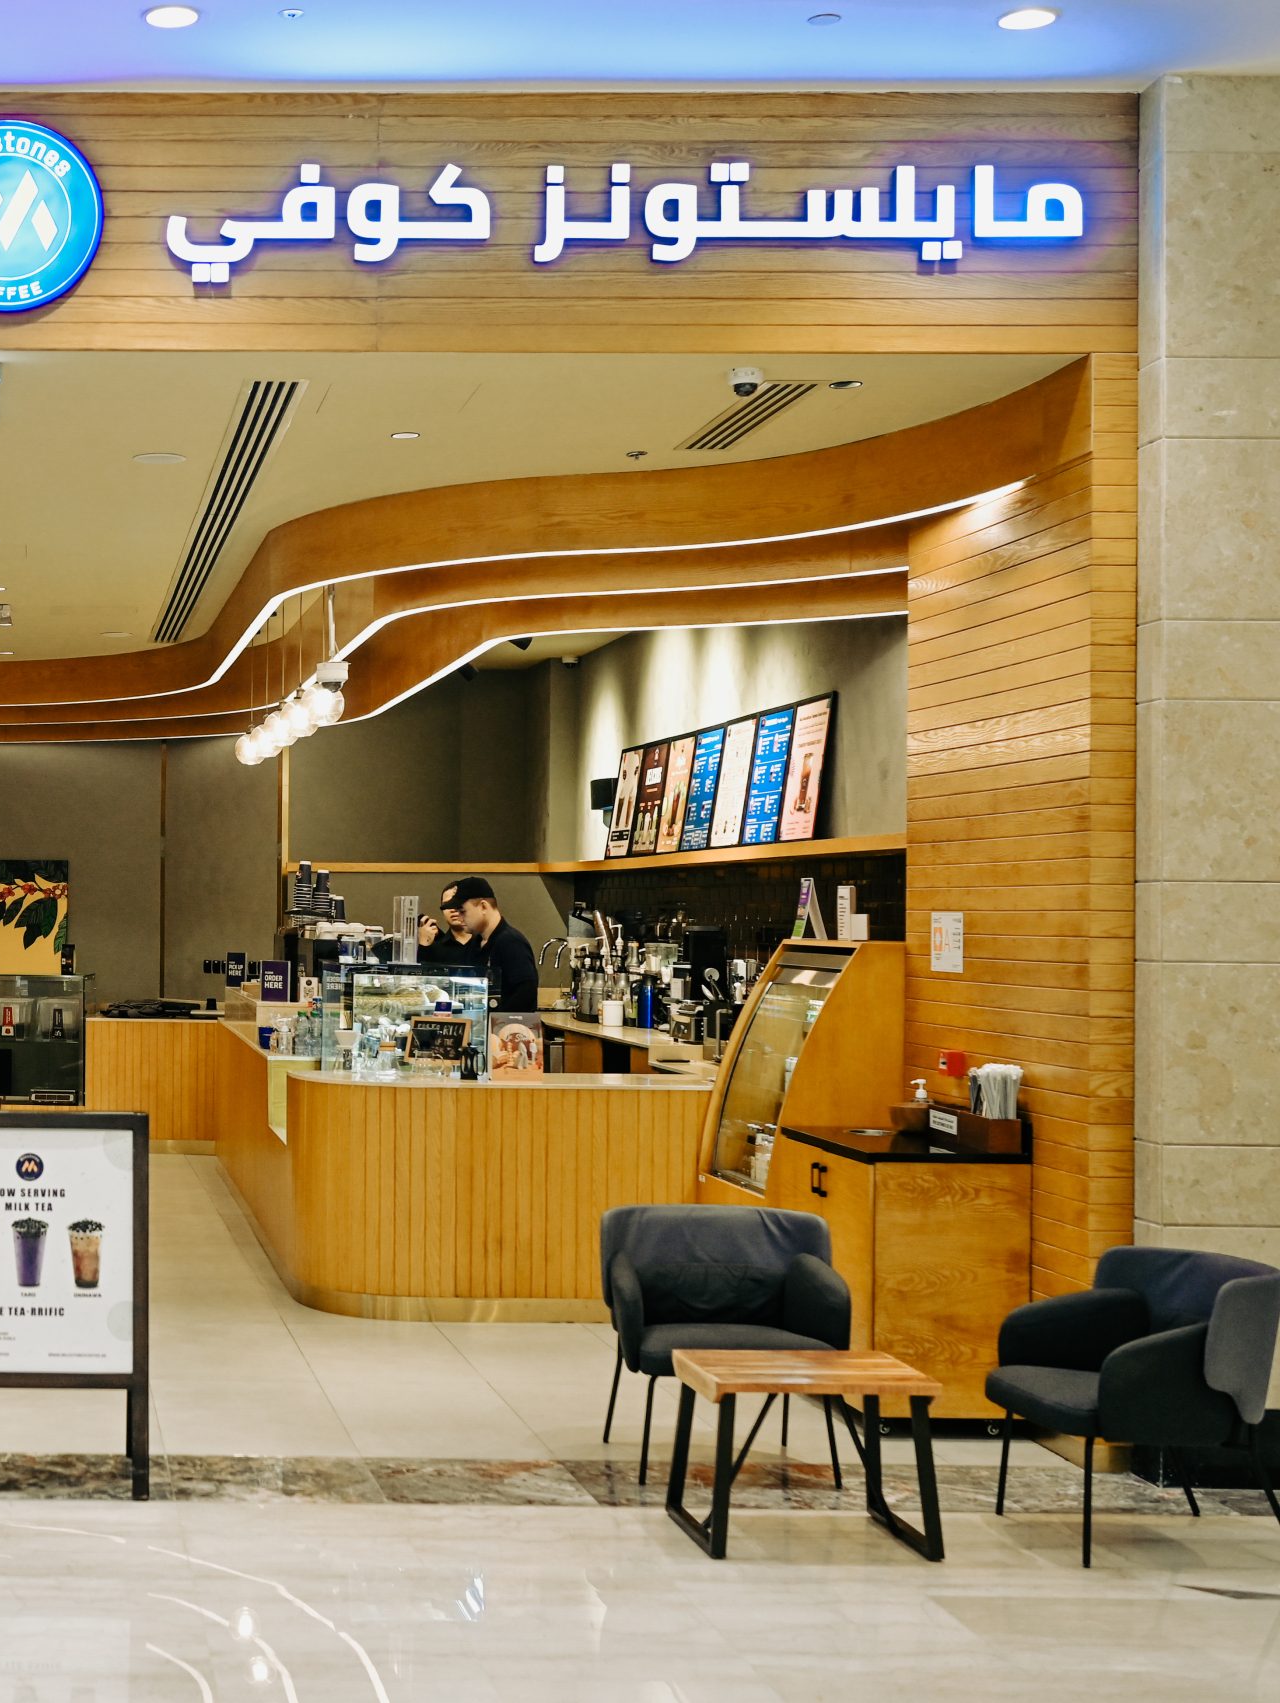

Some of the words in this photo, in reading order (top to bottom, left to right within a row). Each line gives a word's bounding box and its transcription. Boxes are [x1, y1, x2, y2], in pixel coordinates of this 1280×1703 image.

[533, 162, 1083, 262] مايلستونز
[166, 163, 491, 283] كوفي
[264, 974, 283, 982] ORDER
[264, 981, 284, 989] HERE
[20, 1188, 66, 1198] SERVING
[4, 1202, 30, 1212] MILK
[35, 1202, 53, 1212] TEA
